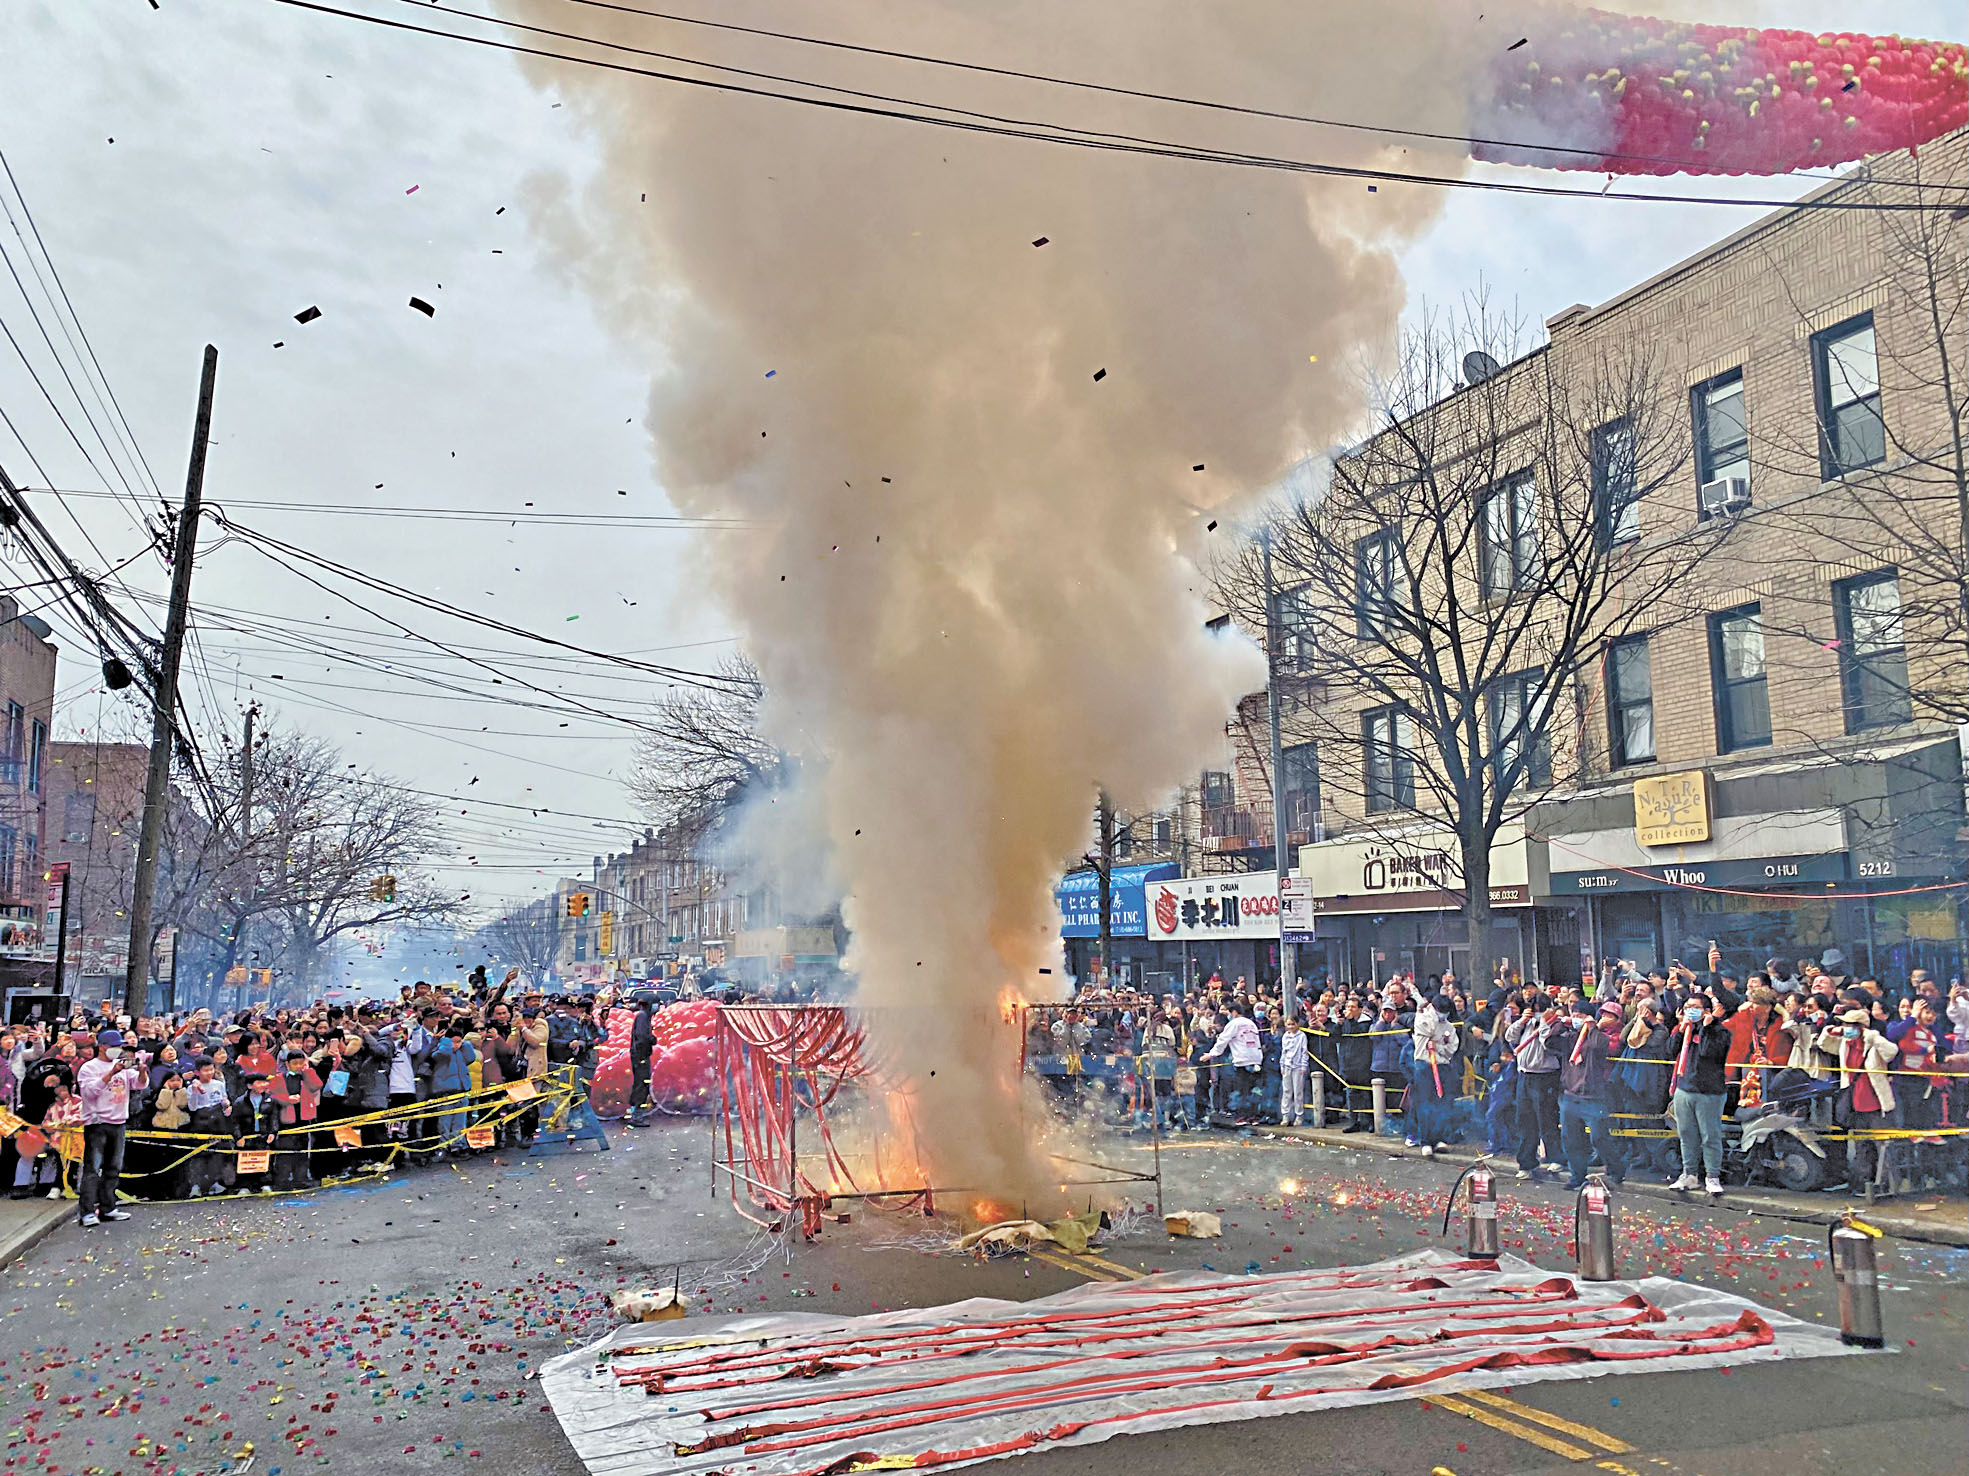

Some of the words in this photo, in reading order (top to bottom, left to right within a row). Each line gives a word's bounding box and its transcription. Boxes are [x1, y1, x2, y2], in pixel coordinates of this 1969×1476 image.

[1641, 827, 1704, 841] collection
[1859, 861, 1891, 876] 5212
[1663, 868, 1706, 885] Whoo
[1220, 883, 1239, 892] CHUAN
[1123, 911, 1142, 924] INC.
